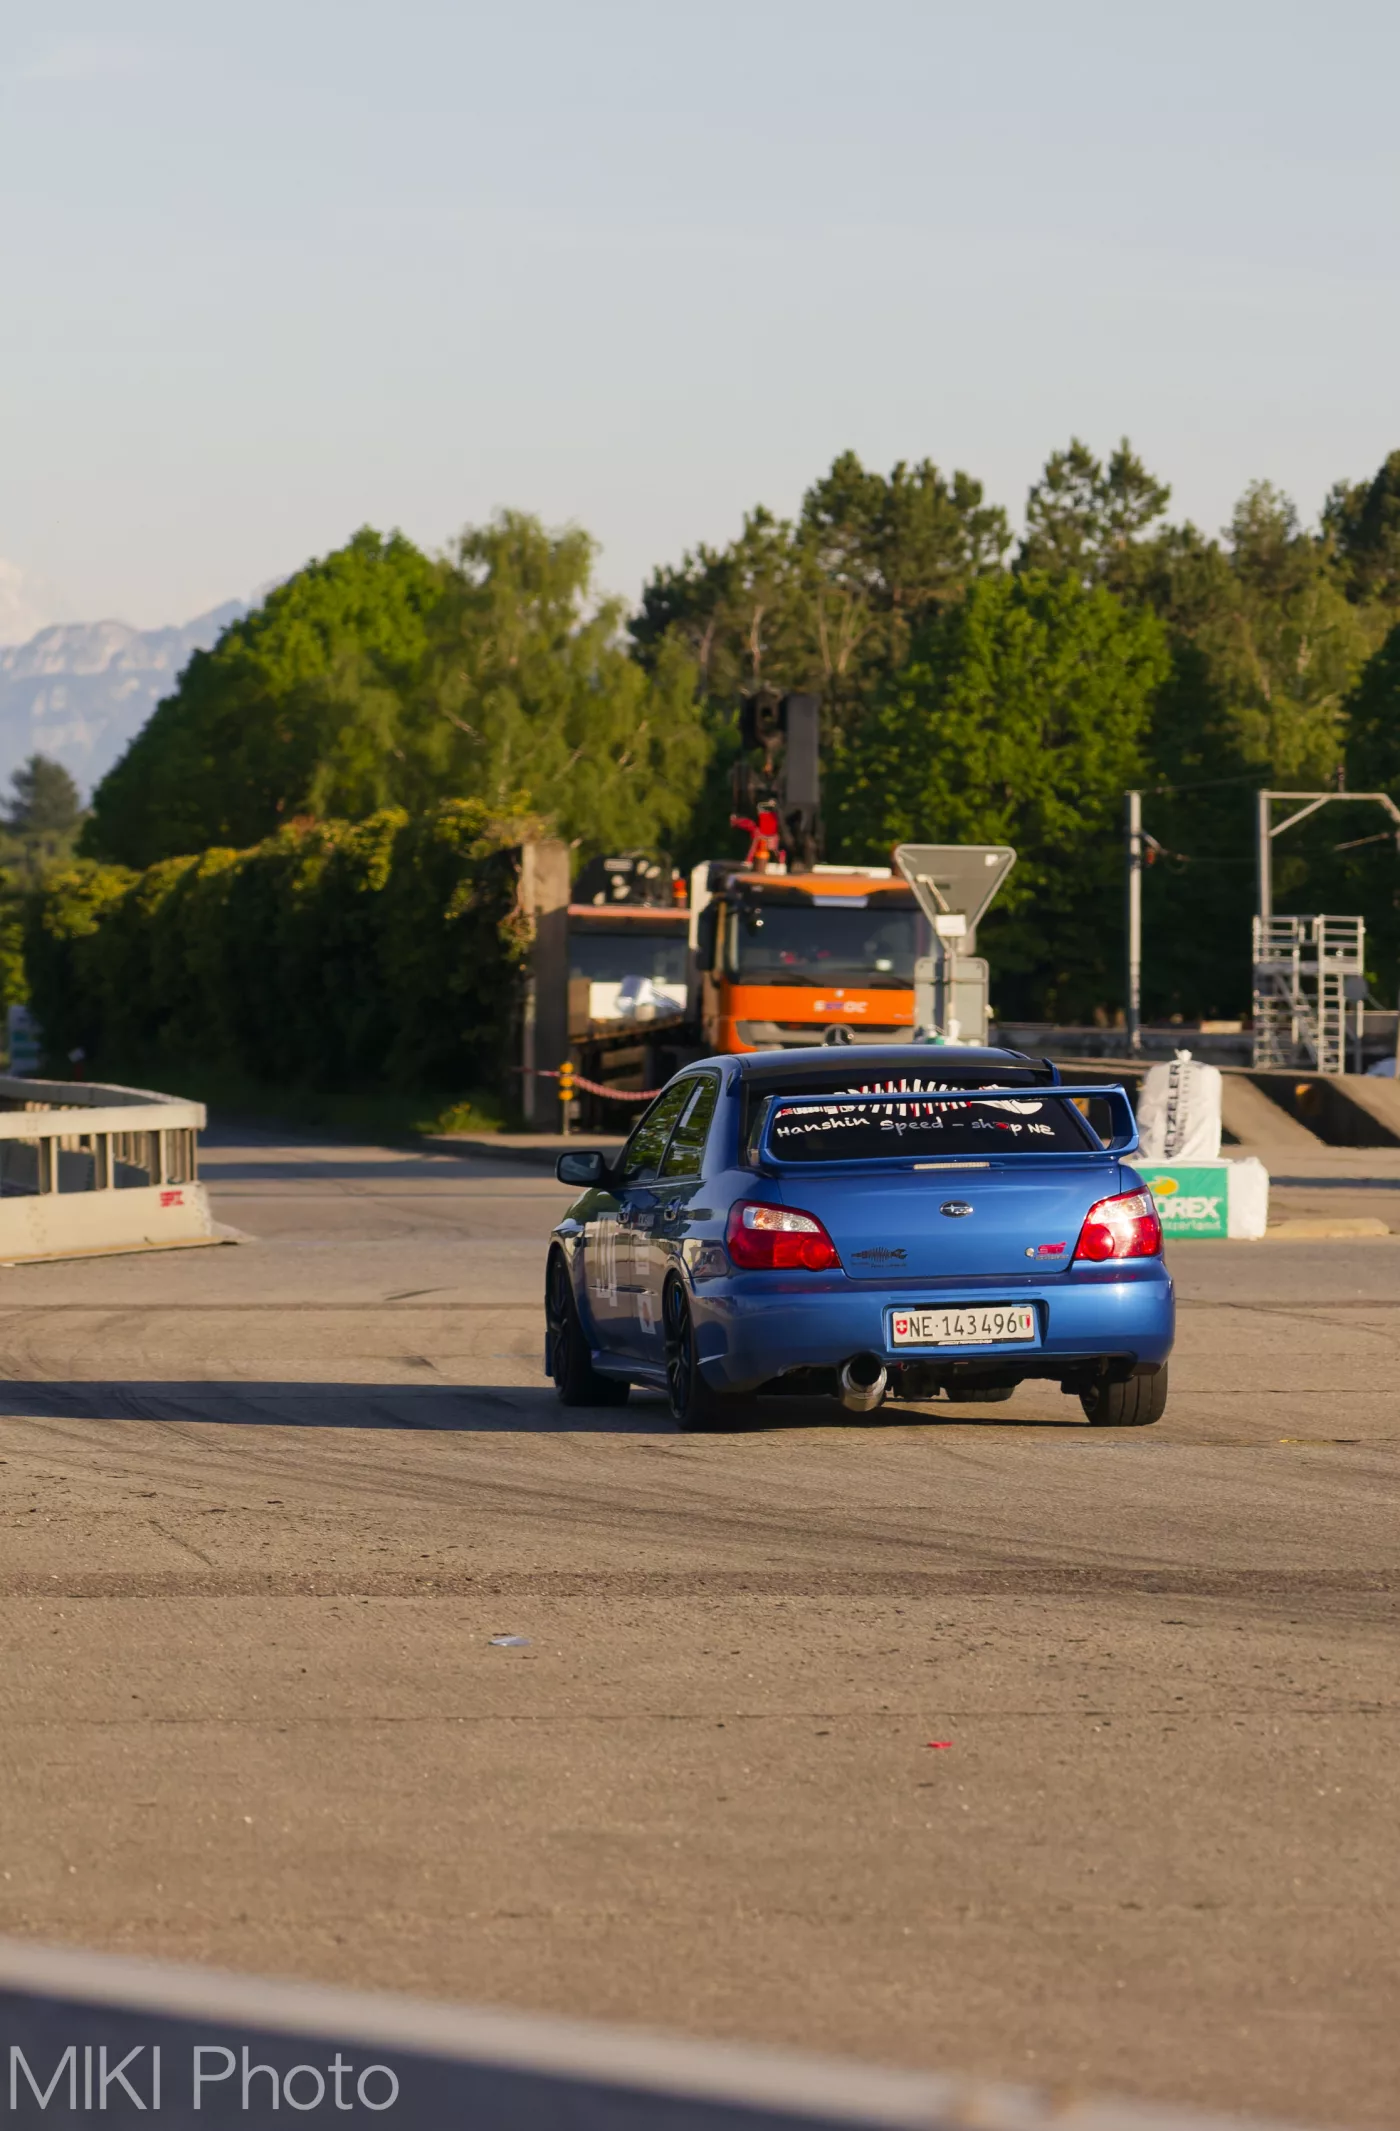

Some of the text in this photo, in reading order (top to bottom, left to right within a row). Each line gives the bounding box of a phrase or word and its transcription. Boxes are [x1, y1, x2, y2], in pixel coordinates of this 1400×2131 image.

[776, 1116, 871, 1138] Hanshin
[879, 1115, 944, 1136] Speed
[1154, 1196, 1223, 1219] OREX
